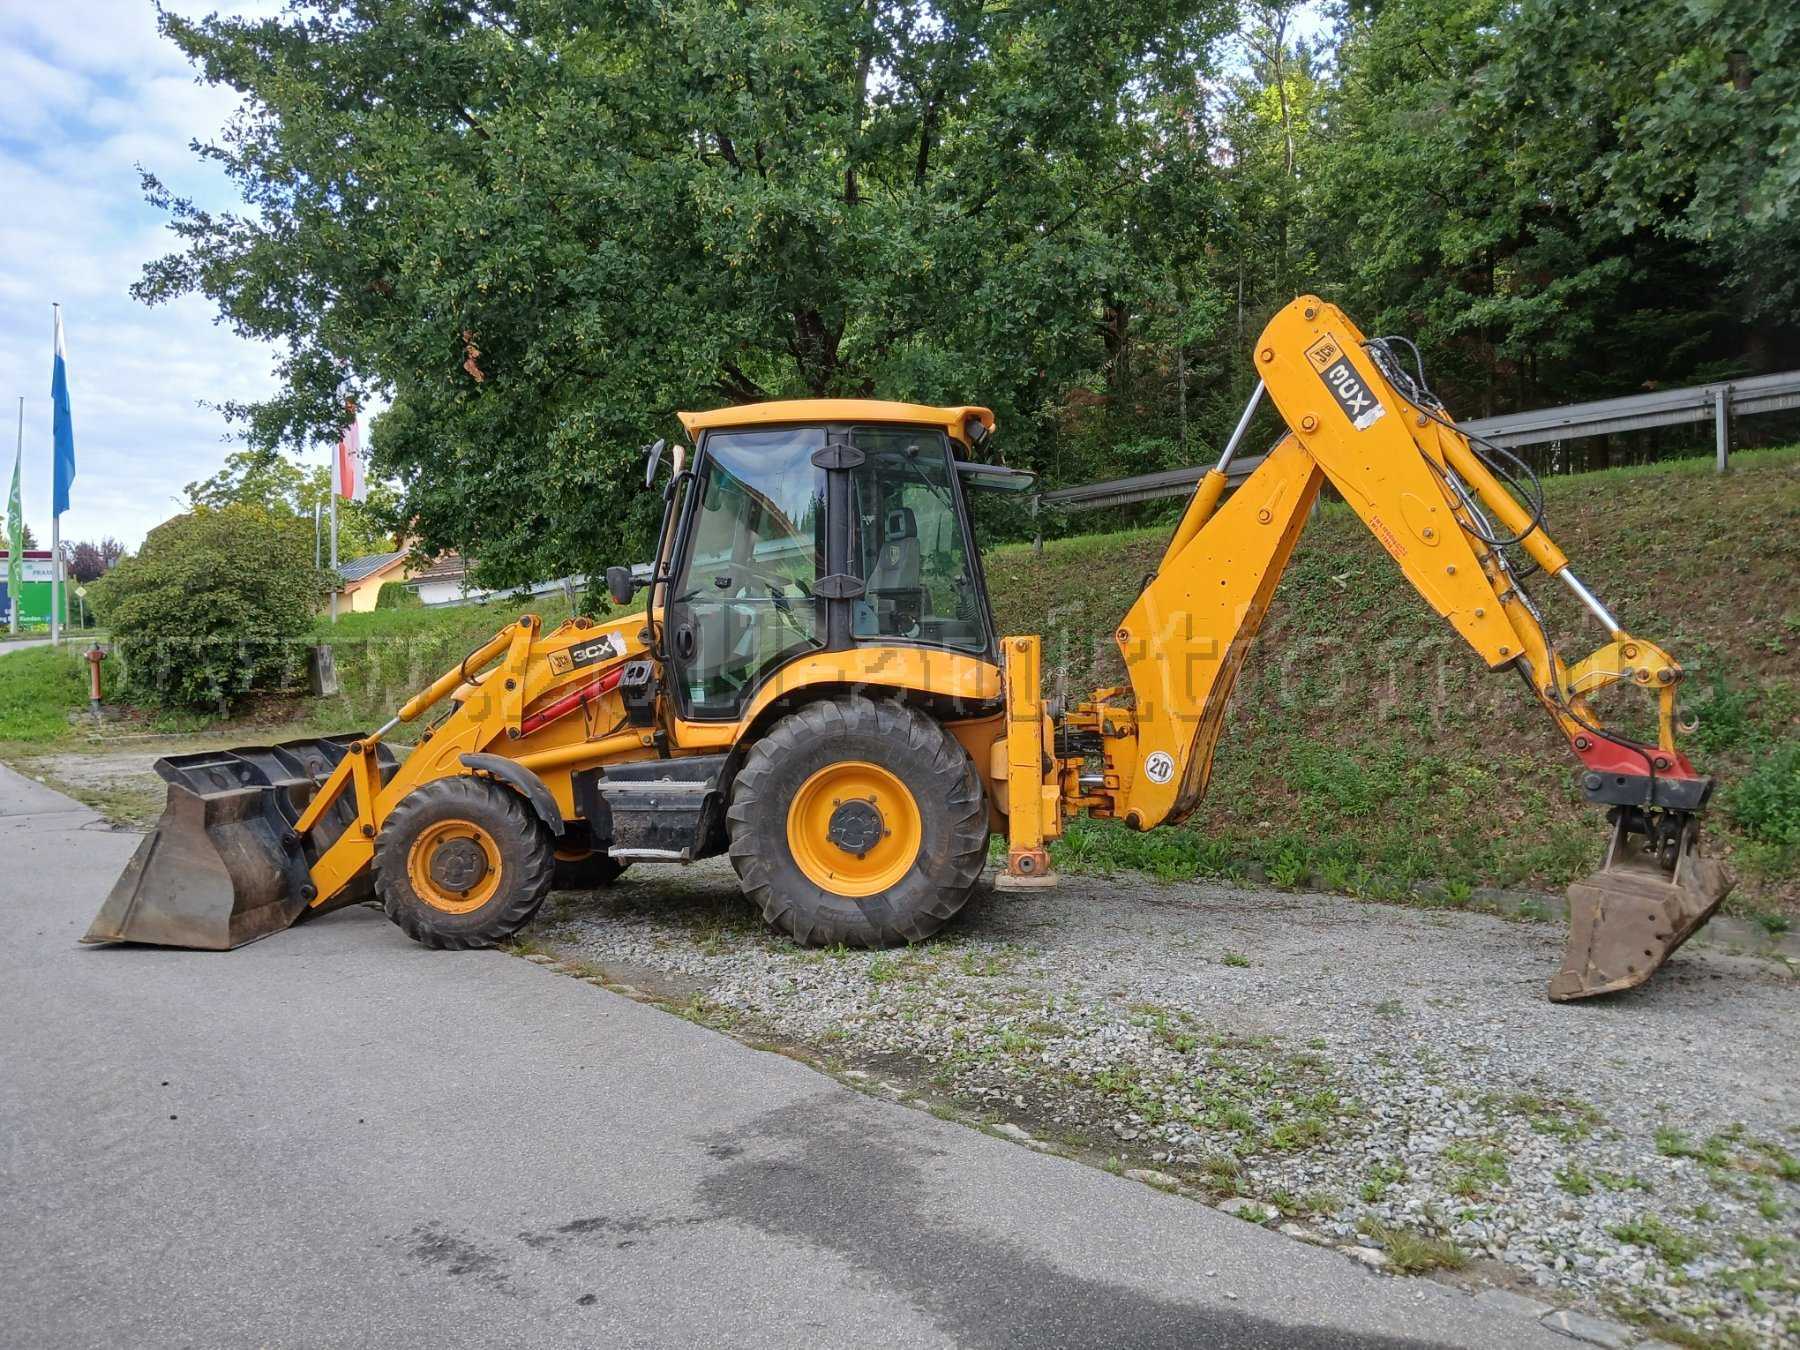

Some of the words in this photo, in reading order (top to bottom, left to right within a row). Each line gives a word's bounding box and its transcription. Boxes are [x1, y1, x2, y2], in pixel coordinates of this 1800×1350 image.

[1314, 343, 1336, 363] JCB
[1328, 363, 1372, 416] 3CX
[573, 641, 613, 662] 3CX
[1149, 757, 1170, 778] 20
